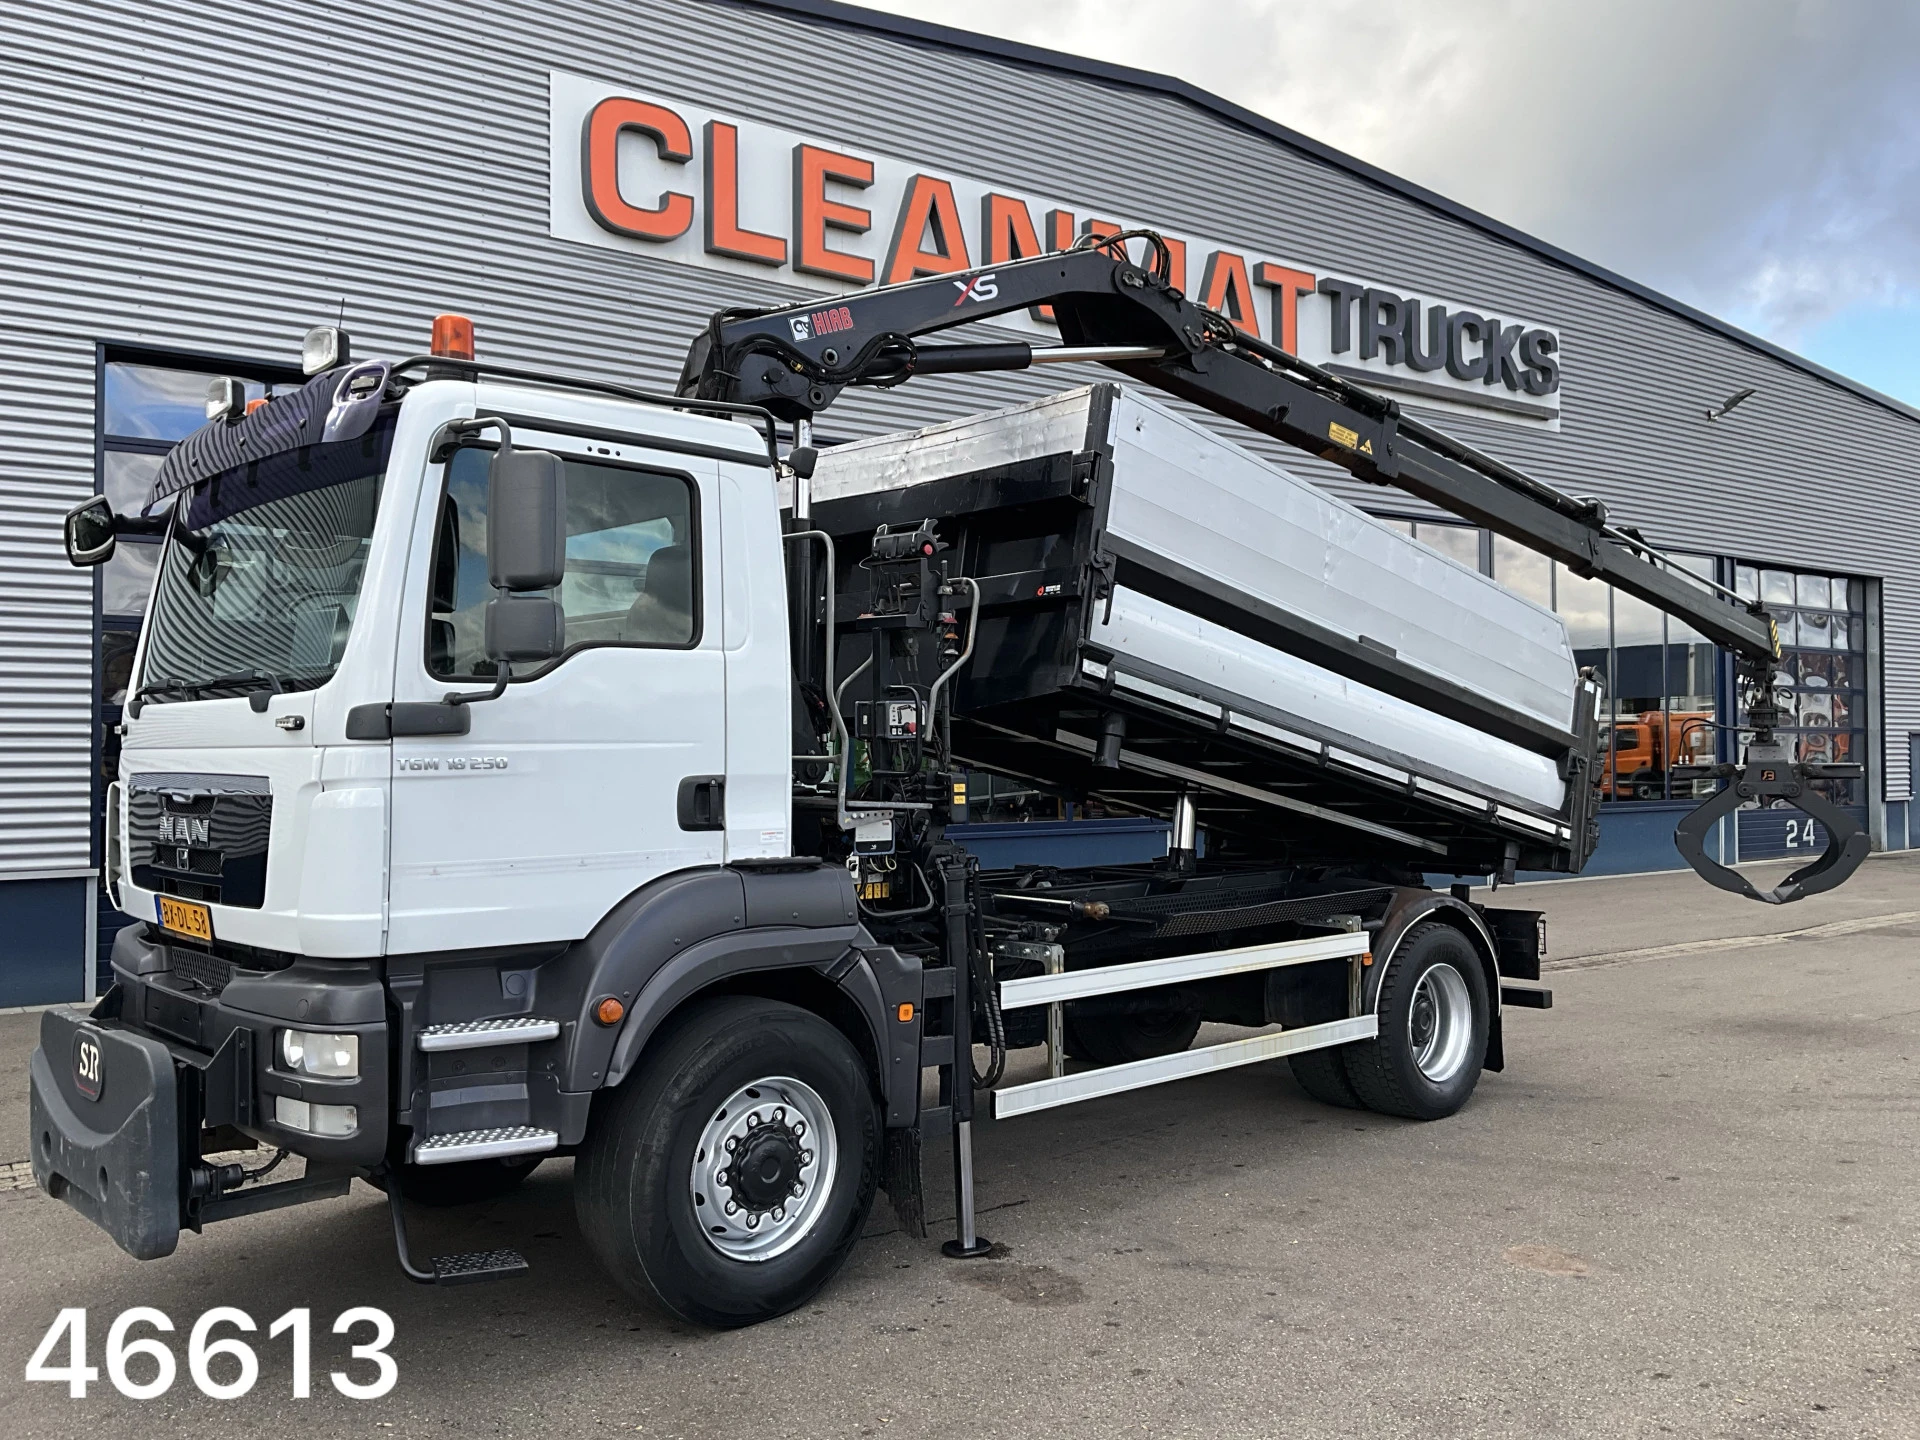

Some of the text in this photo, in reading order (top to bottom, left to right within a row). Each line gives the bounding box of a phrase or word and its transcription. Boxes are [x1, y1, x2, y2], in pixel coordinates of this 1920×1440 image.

[953, 273, 999, 306] XS
[811, 307, 853, 336] HIAB
[1318, 277, 1560, 396] TRUCKS
[396, 756, 508, 771] TGM 18 250
[159, 816, 210, 844] MAN
[1786, 818, 1816, 848] 24
[79, 1041, 99, 1082] SR
